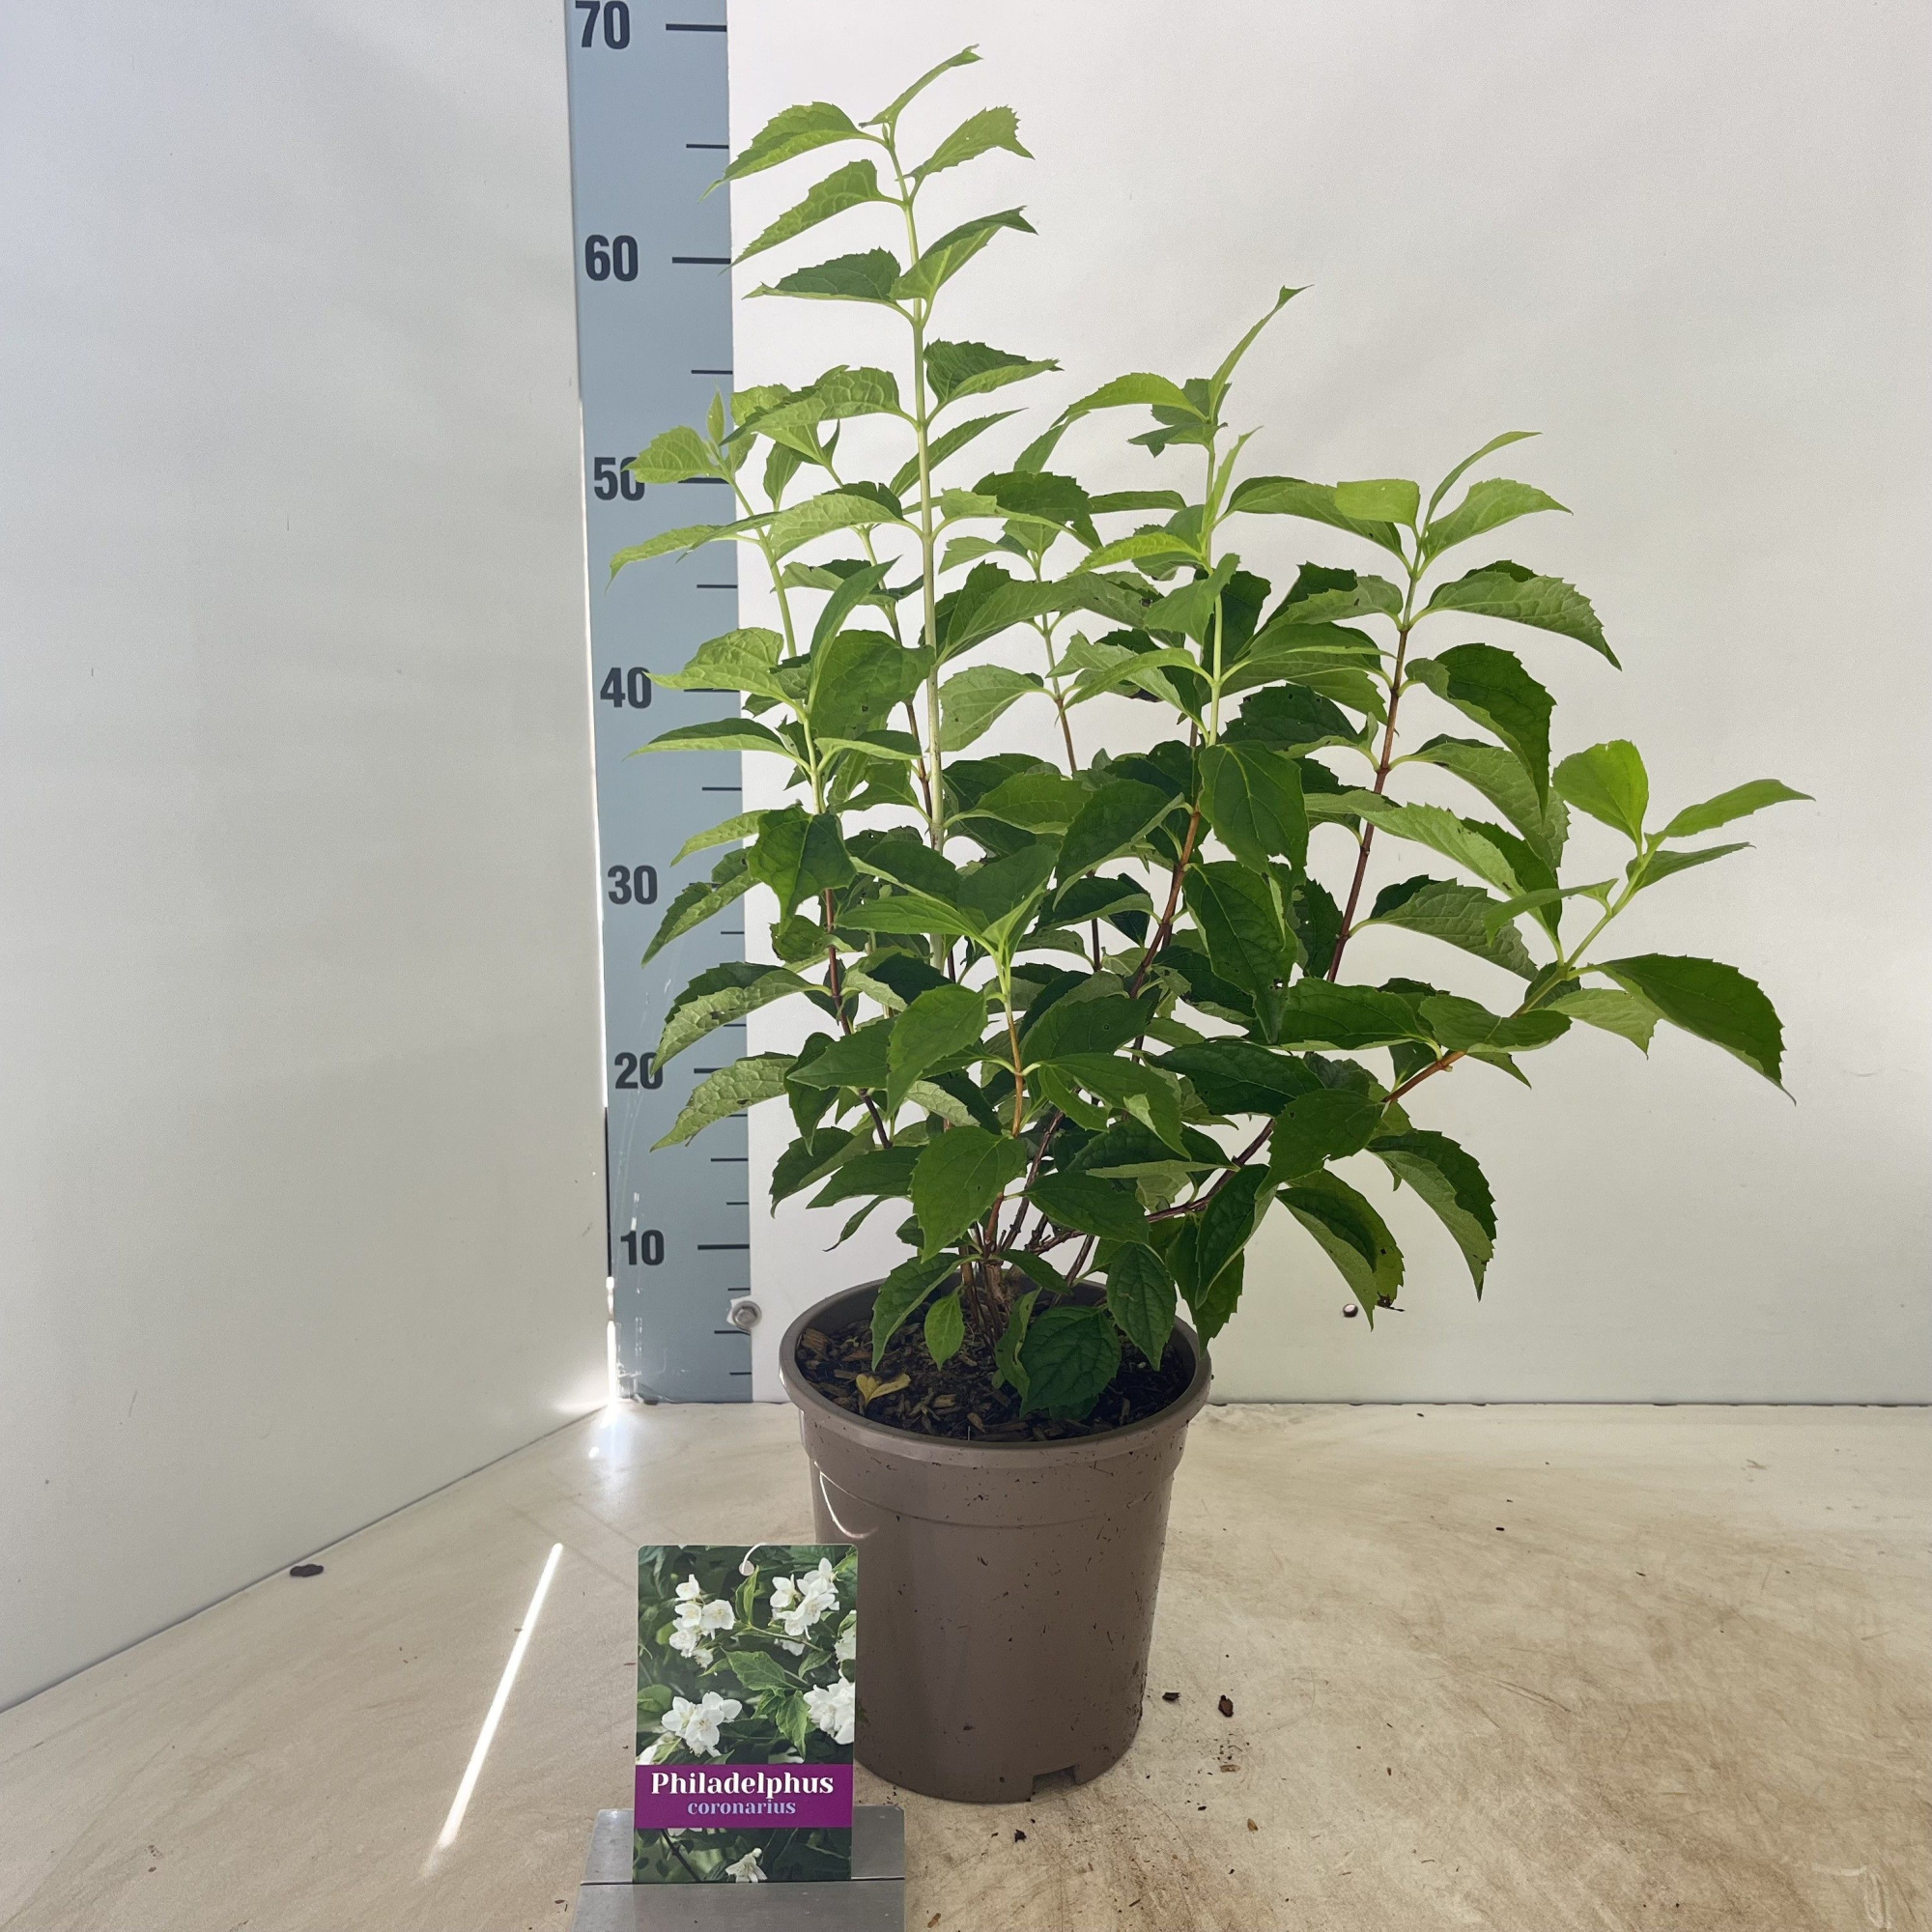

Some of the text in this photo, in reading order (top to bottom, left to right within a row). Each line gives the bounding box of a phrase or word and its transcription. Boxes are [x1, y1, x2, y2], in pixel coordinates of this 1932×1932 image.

[575, 0, 631, 49] 70
[584, 234, 639, 281] 60
[593, 456, 645, 501] 50
[600, 667, 652, 709] 40
[607, 865, 658, 905] 30
[613, 1051, 664, 1090] 20
[620, 1229, 665, 1265] 10
[651, 1772, 834, 1799] Philadelphus
[687, 1799, 796, 1815] coronarius
